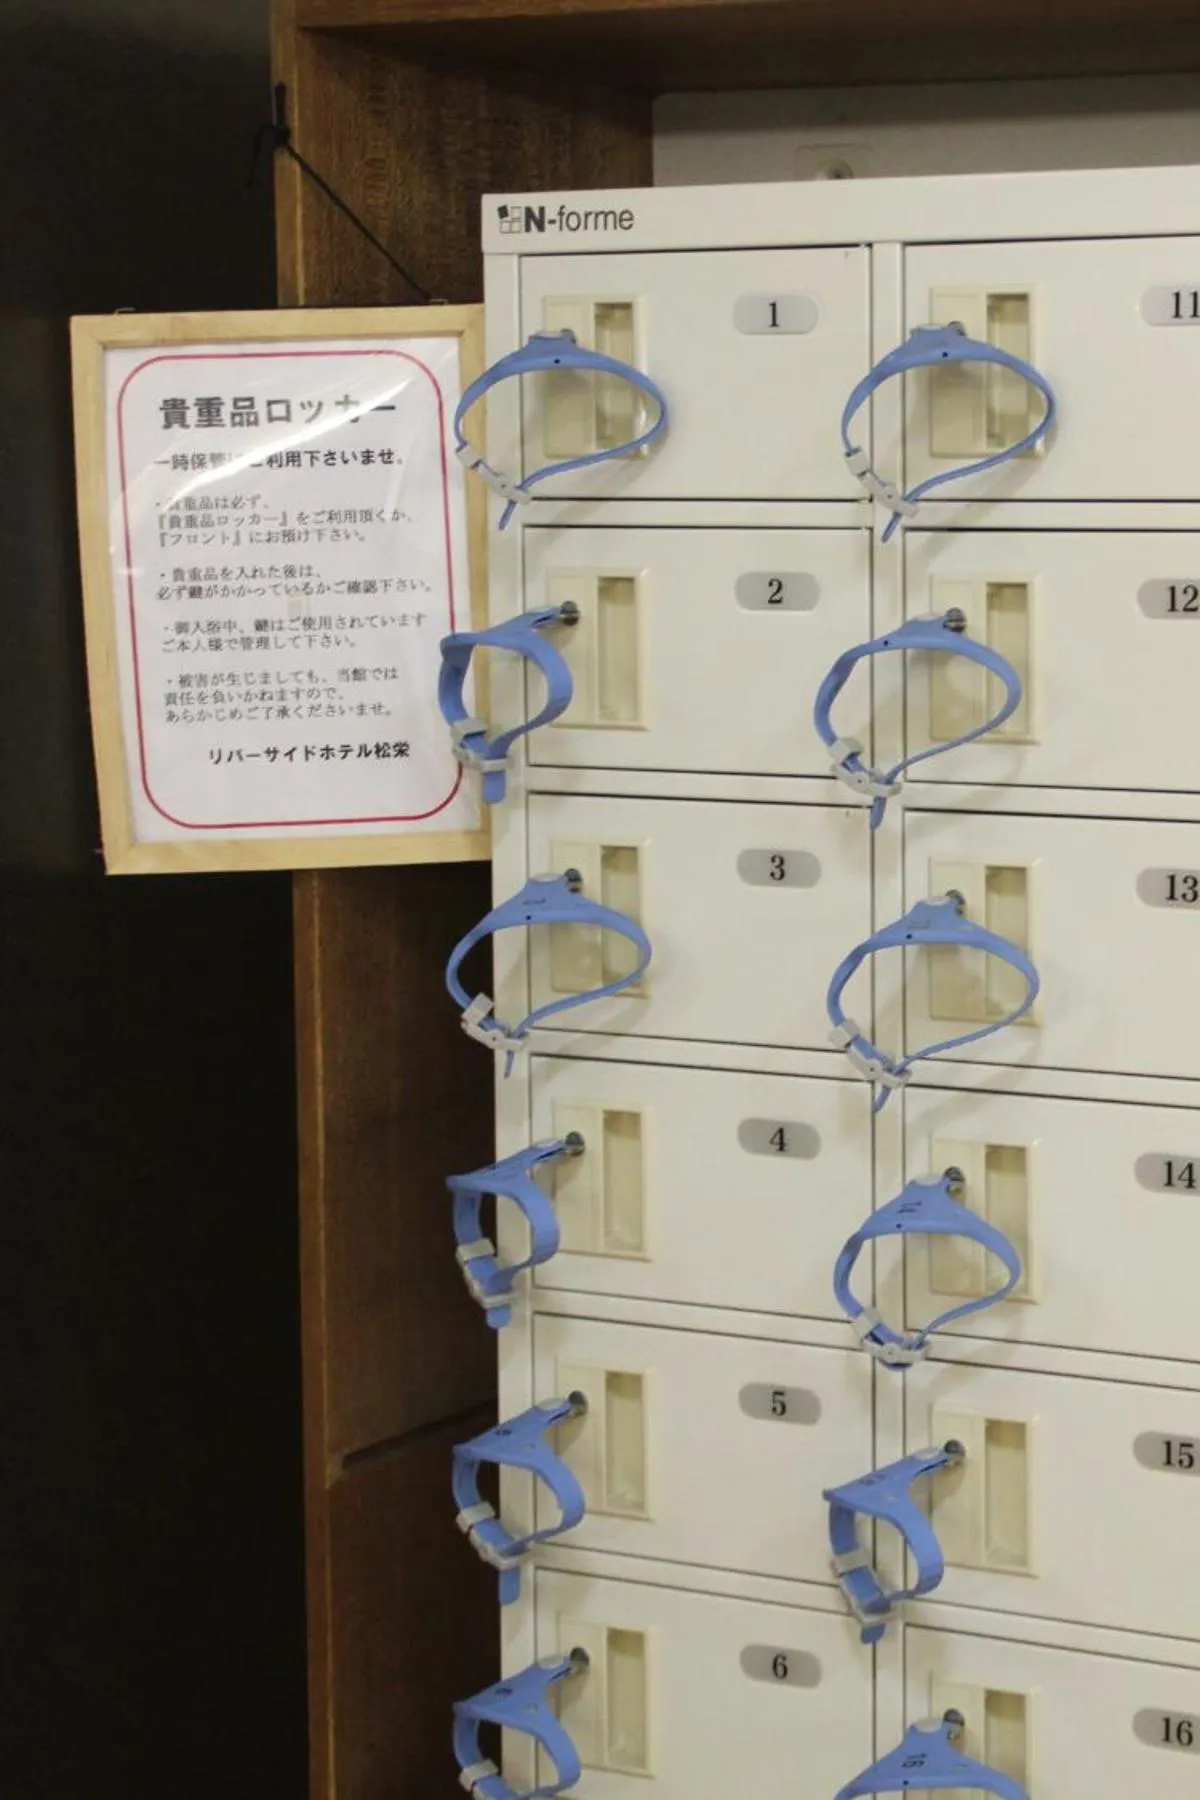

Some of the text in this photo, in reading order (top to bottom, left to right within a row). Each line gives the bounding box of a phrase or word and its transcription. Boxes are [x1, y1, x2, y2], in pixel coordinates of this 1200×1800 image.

[524, 205, 634, 233] N-forme
[768, 301, 780, 328] 1
[1172, 291, 1200, 319] 11
[767, 578, 784, 605] 2
[1167, 584, 1199, 613] 12
[209, 741, 411, 765] リバーサイドホテル松栄
[769, 854, 786, 881] 3
[1165, 874, 1198, 904] 13
[769, 1126, 788, 1153] 4
[1164, 1160, 1197, 1190] 14
[771, 1389, 788, 1417] 5
[1162, 1439, 1195, 1470] 15
[771, 1652, 789, 1681] 6
[1161, 1716, 1194, 1747] 16
